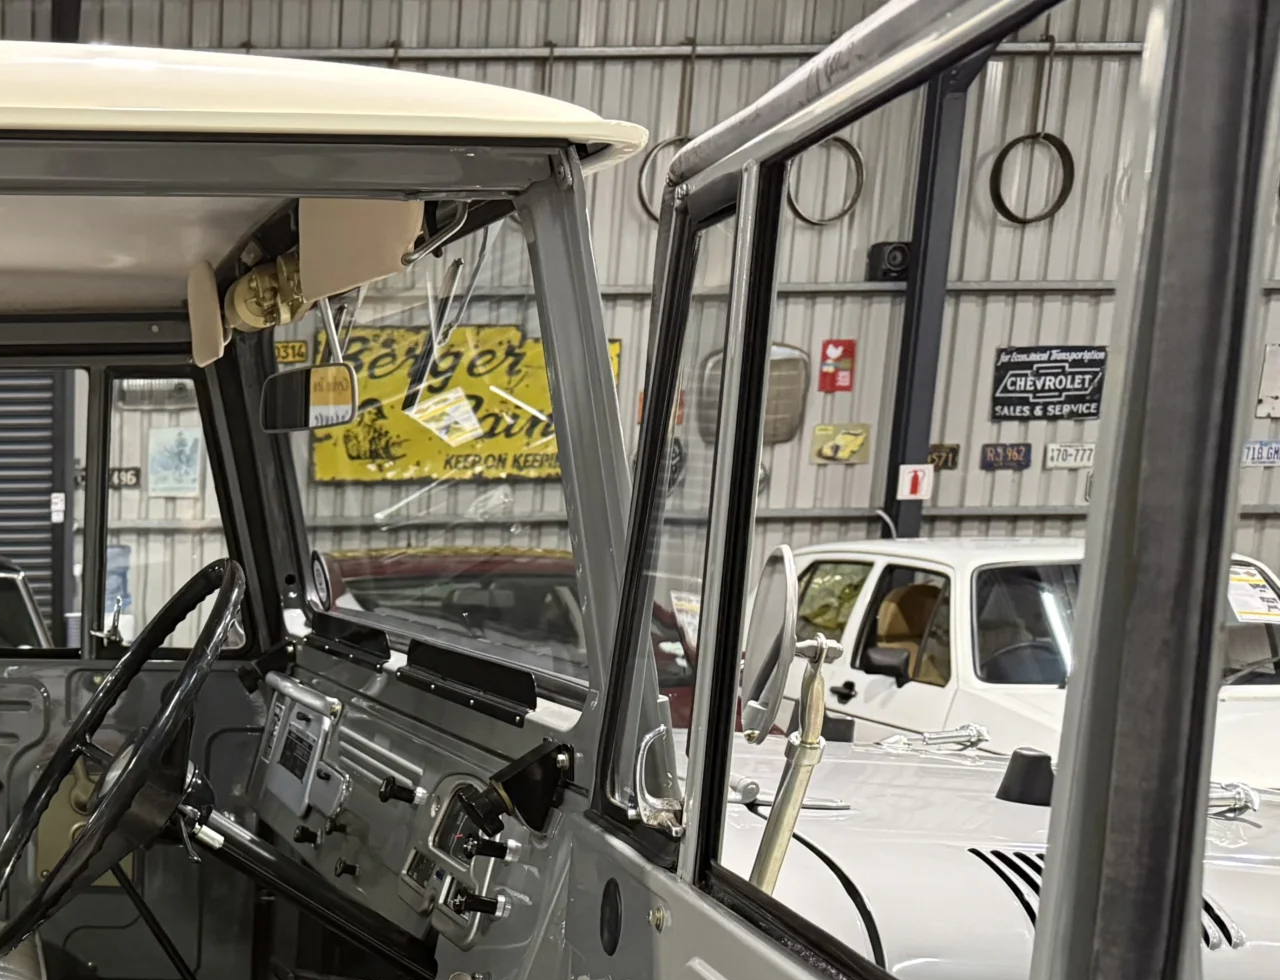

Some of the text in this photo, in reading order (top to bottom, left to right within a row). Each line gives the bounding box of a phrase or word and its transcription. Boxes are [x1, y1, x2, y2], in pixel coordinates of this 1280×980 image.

[1050, 349, 1106, 362] Transportation
[1006, 375, 1093, 391] CHEVROLET
[995, 403, 1098, 416] SALES & SERVICE
[443, 453, 481, 470] KEEP
[483, 453, 507, 470] ON
